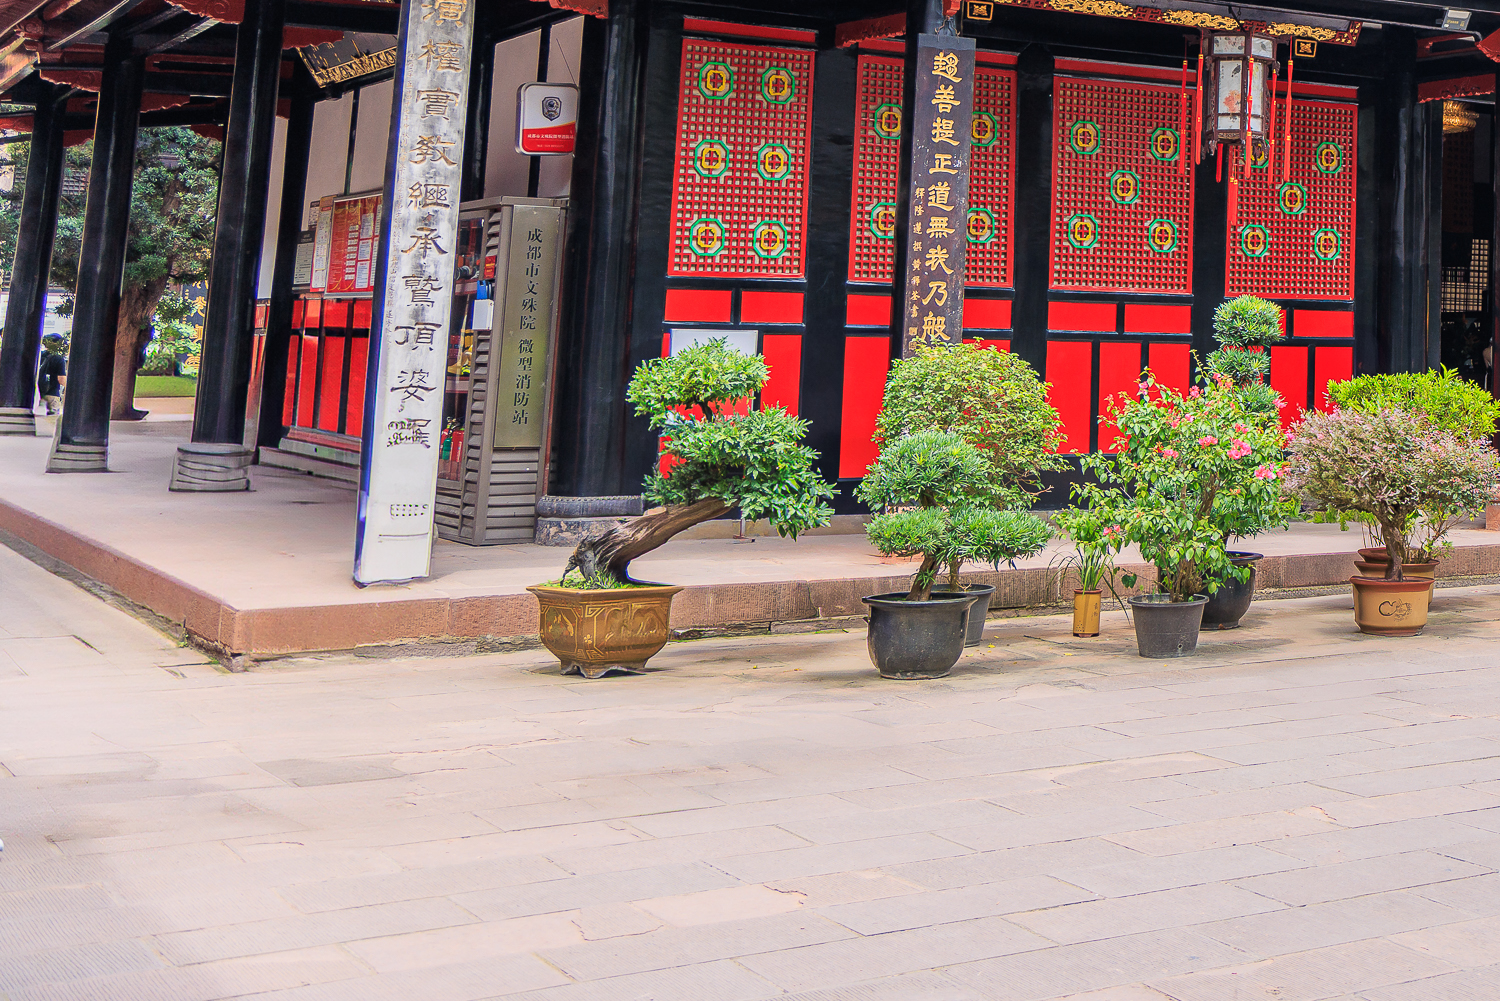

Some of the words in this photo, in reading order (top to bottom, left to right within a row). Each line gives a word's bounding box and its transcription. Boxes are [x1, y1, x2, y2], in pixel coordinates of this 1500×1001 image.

[519, 227, 543, 330] 成都市文殊院
[512, 339, 534, 425] 微型消防站
